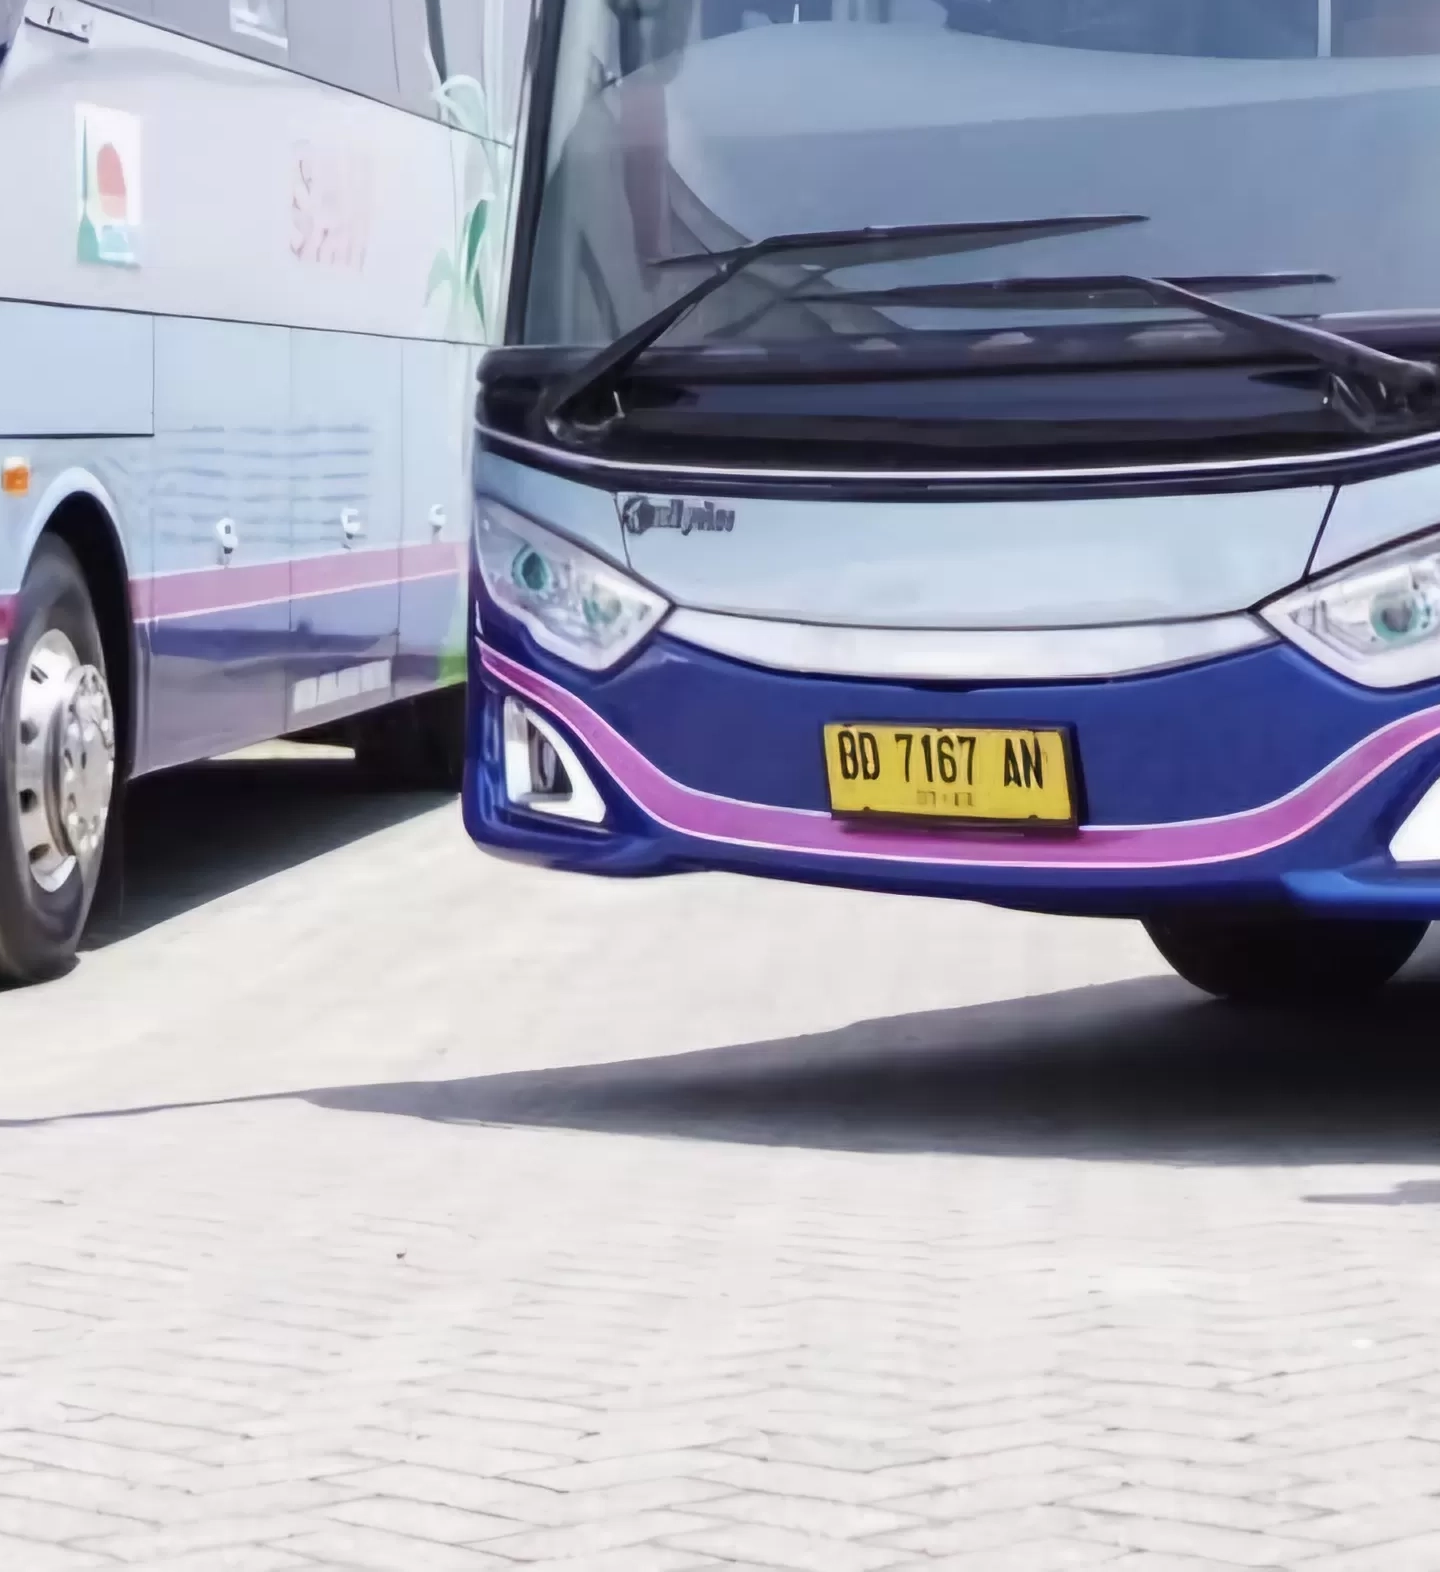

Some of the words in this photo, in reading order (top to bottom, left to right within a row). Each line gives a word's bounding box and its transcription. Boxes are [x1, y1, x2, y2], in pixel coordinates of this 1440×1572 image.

[837, 730, 881, 780] BD
[894, 733, 976, 786] 7167
[1003, 738, 1044, 789] AN
